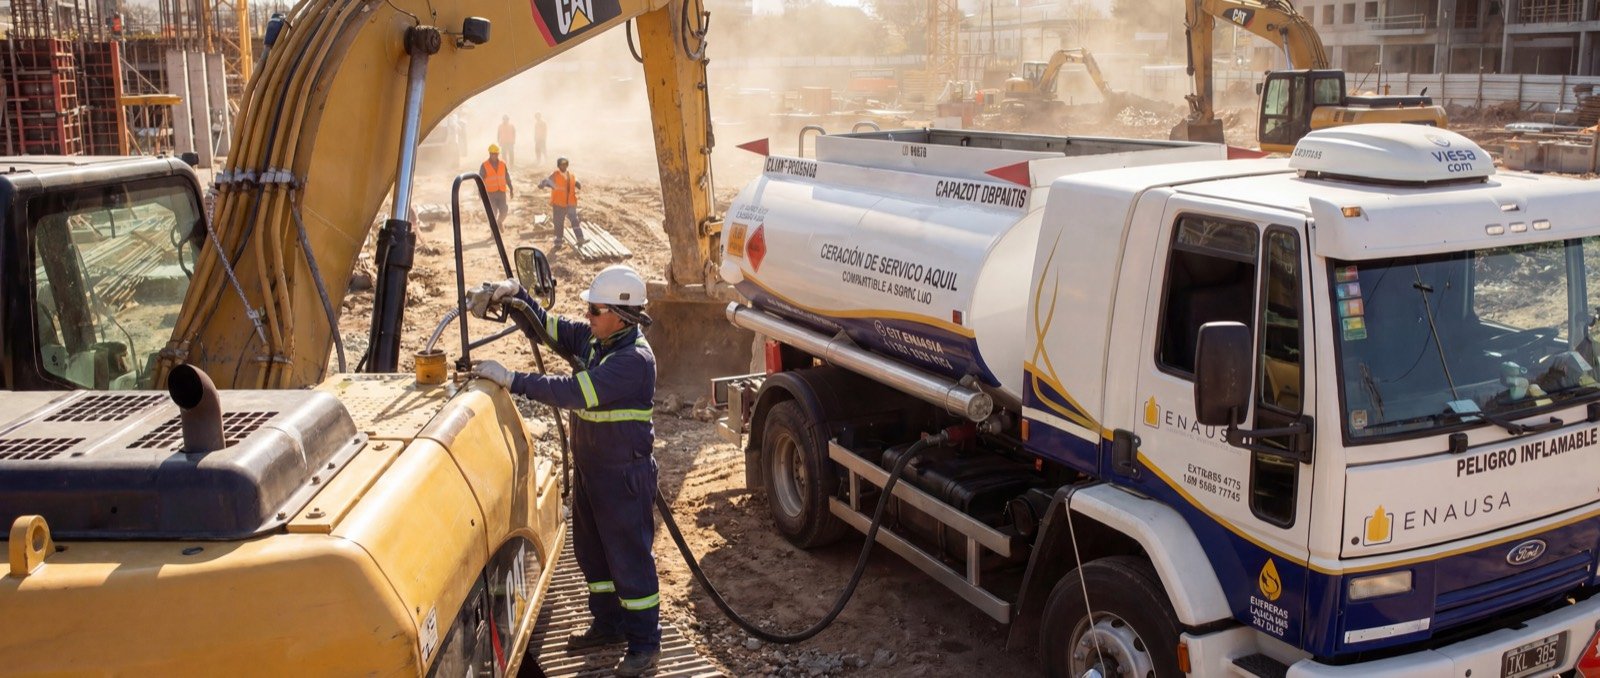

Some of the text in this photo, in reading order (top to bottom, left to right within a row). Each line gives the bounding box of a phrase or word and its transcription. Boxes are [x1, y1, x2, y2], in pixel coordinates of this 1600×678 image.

[1232, 9, 1247, 25] CAT
[1447, 161, 1472, 173] com
[936, 181, 981, 202] CAPAZOT
[820, 245, 958, 291] CERACIÓN DE SERVICO AQUIL
[887, 283, 893, 295] A
[1165, 410, 1229, 444] ENAUS
[1457, 428, 1597, 477] PELIGRO INFLAMABLE
[1223, 477, 1241, 491] 4775
[1404, 491, 1511, 530] ENAUSA
[506, 539, 527, 635] CAT
[1507, 641, 1557, 676] IKL 385
